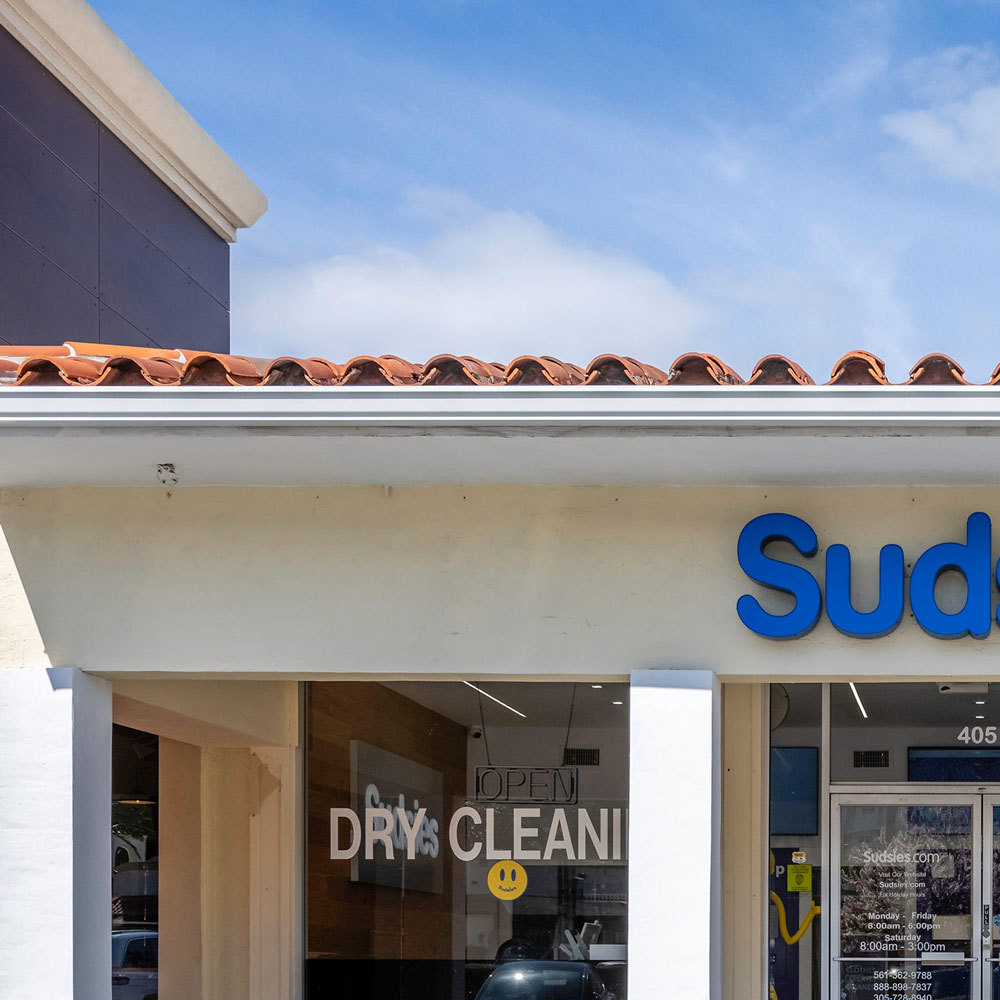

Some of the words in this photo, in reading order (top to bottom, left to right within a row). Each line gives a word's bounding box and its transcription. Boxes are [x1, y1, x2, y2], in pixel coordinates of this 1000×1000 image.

[957, 726, 998, 744] 405
[479, 768, 574, 802] OPEN
[329, 807, 427, 860] DRY
[449, 806, 629, 862] CLEANI
[863, 850, 940, 863] Sudsies.com
[868, 912, 900, 921] Monday
[911, 911, 937, 921] Friday
[907, 922, 941, 931] 6:00pm
[884, 934, 922, 942] Saturday
[859, 941, 898, 951] 8:00am
[907, 941, 946, 953] 3:00pm
[873, 971, 932, 980] 561-362-9788
[873, 982, 932, 991] 888-898-7837
